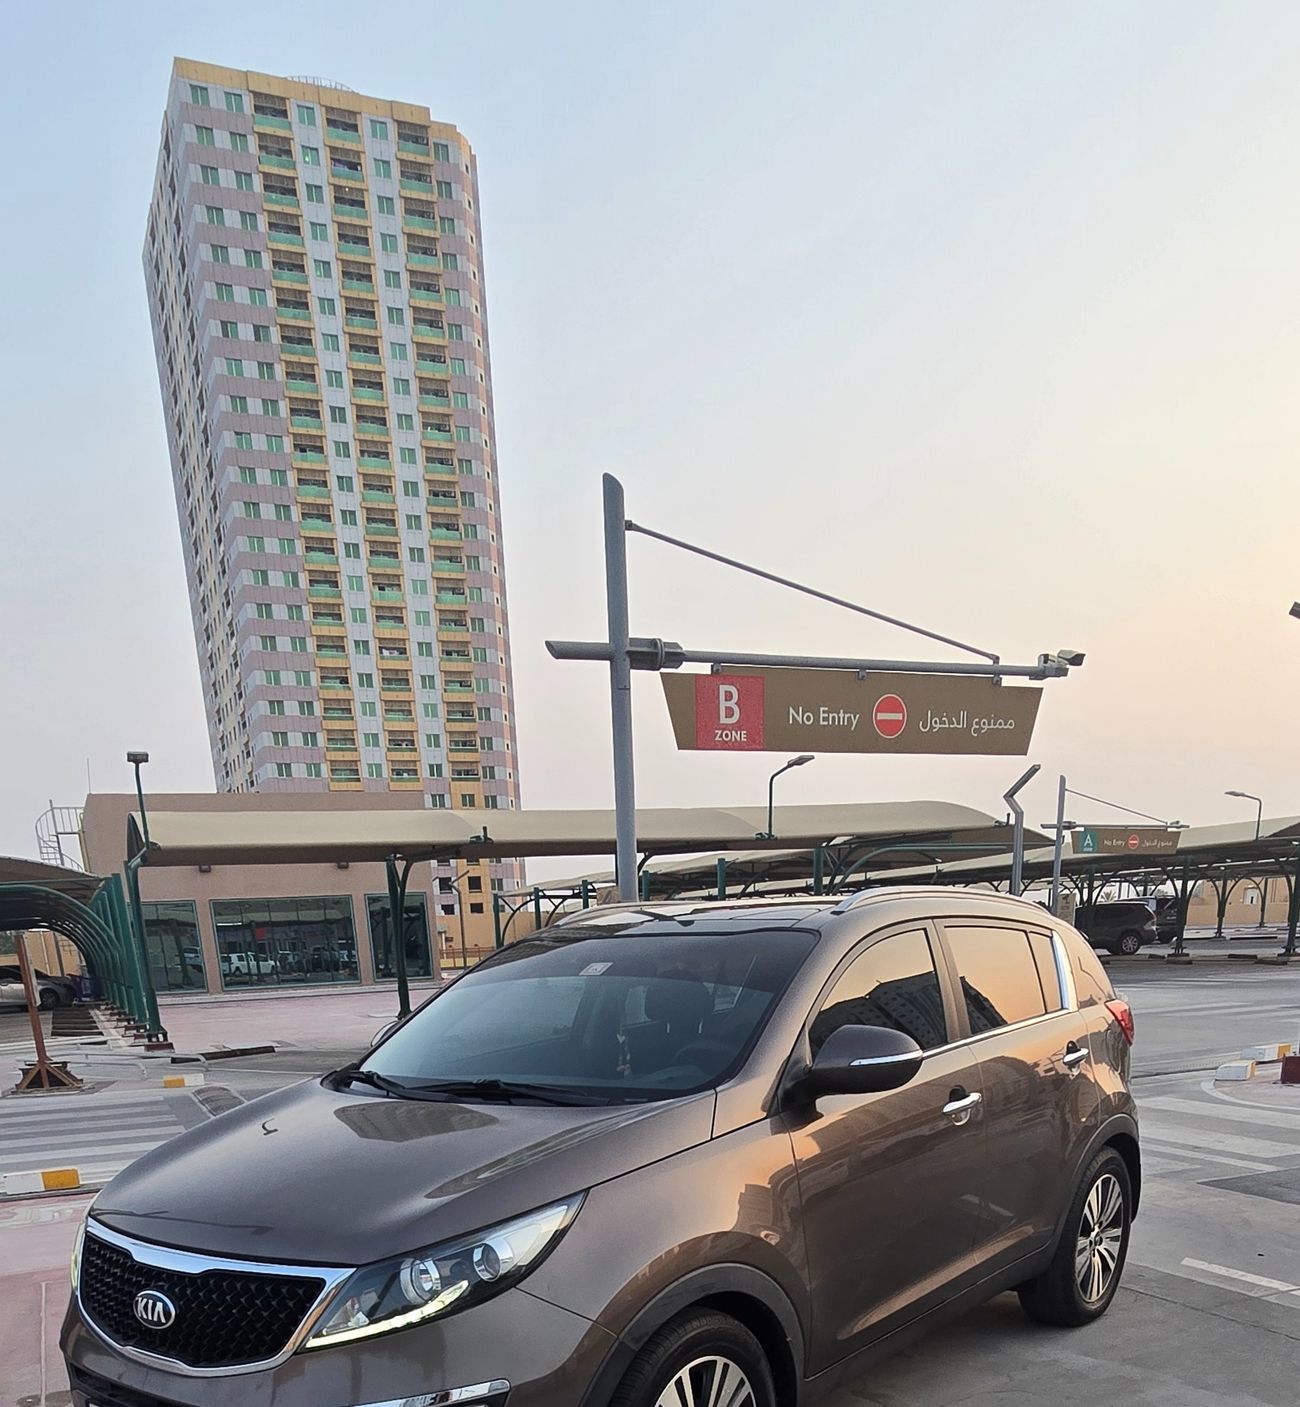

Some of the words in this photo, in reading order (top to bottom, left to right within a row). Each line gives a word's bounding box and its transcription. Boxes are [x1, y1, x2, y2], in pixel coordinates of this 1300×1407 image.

[719, 684, 740, 724] B
[789, 706, 813, 725] No
[819, 707, 859, 731] Entry
[919, 709, 967, 732] الدخول
[971, 713, 1015, 736] ممنوع
[714, 730, 747, 741] ZONE
[1083, 834, 1093, 847] A
[137, 1297, 166, 1323] KIA
